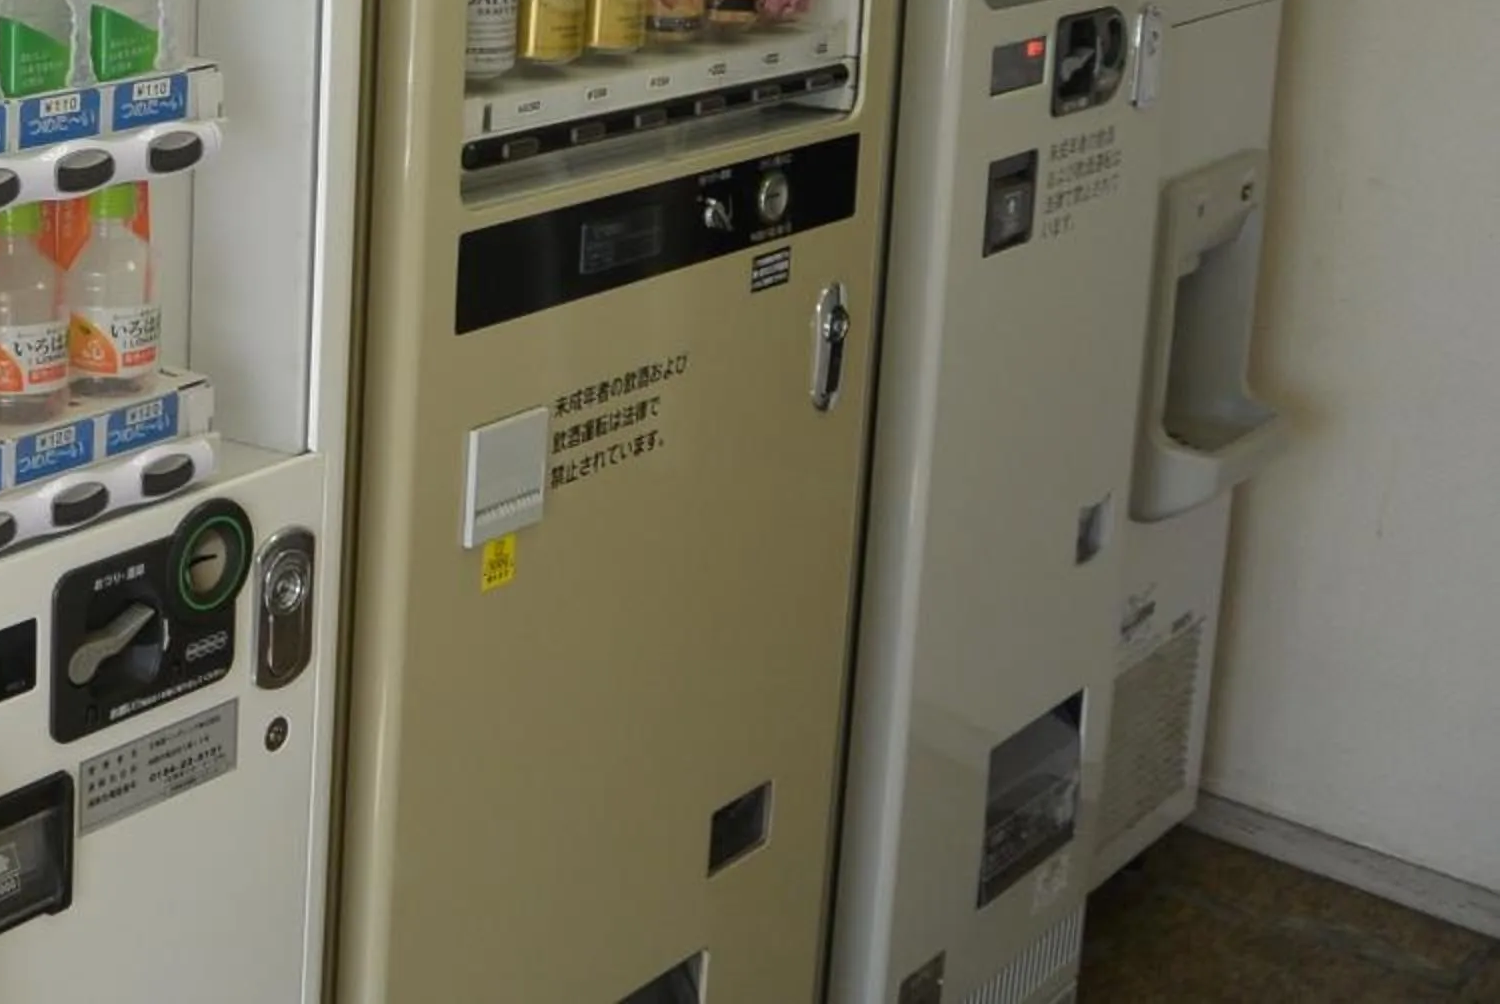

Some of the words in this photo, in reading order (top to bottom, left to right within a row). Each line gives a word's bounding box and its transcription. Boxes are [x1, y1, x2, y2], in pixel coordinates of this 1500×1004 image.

[554, 355, 688, 418] 未成年者の飲酒および
[552, 396, 661, 455] 飲酒運転は法律で
[551, 429, 665, 489] 禁止されています。
